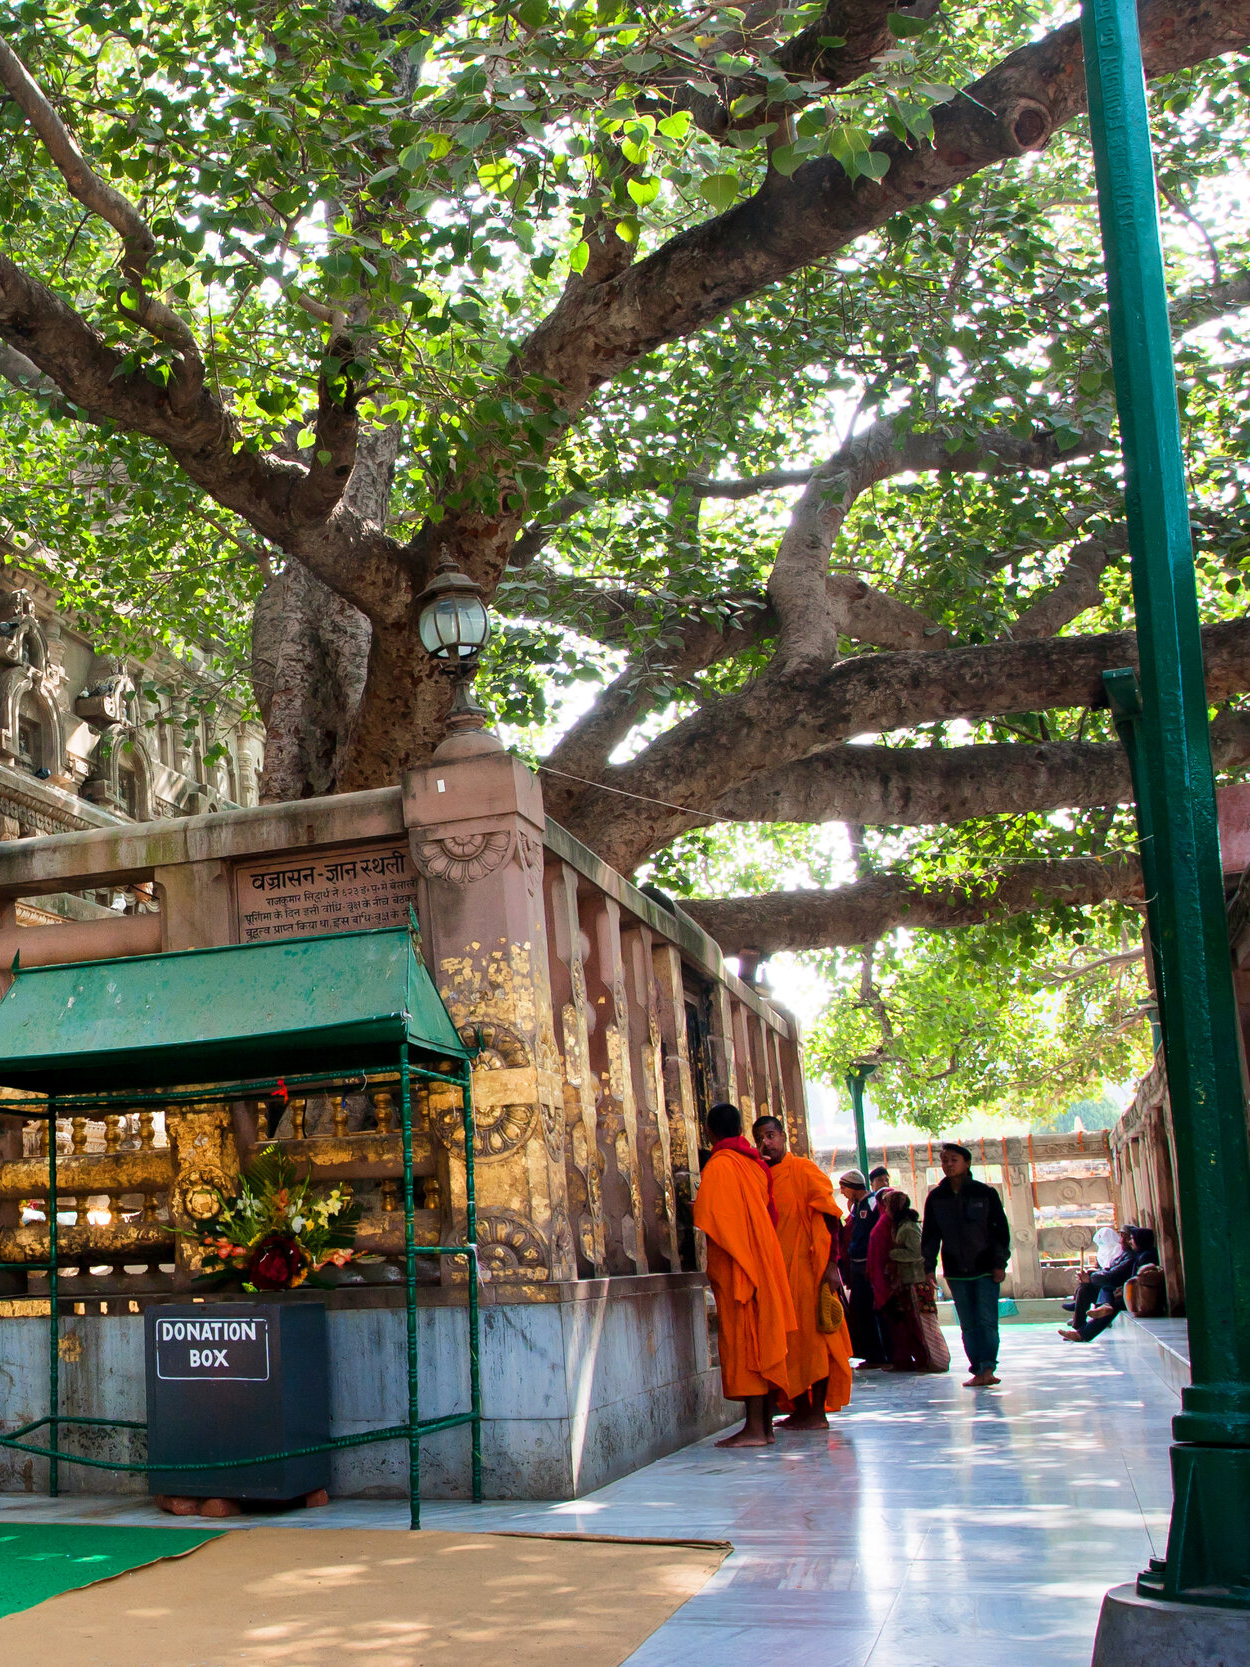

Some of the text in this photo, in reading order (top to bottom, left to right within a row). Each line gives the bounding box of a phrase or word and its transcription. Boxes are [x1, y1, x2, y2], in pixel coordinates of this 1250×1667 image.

[360, 850, 406, 879] स्थली
[266, 894, 301, 908] राजकुमार
[331, 887, 339, 898] ने
[273, 909, 282, 919] के
[285, 907, 300, 919] दिन
[302, 904, 319, 917] इसी
[361, 897, 370, 908] के
[372, 895, 389, 906] नीचे
[295, 920, 318, 931] किया
[332, 916, 349, 928] इस
[390, 908, 399, 919] के
[162, 1322, 257, 1341] DONATION
[189, 1349, 230, 1368] BOX
